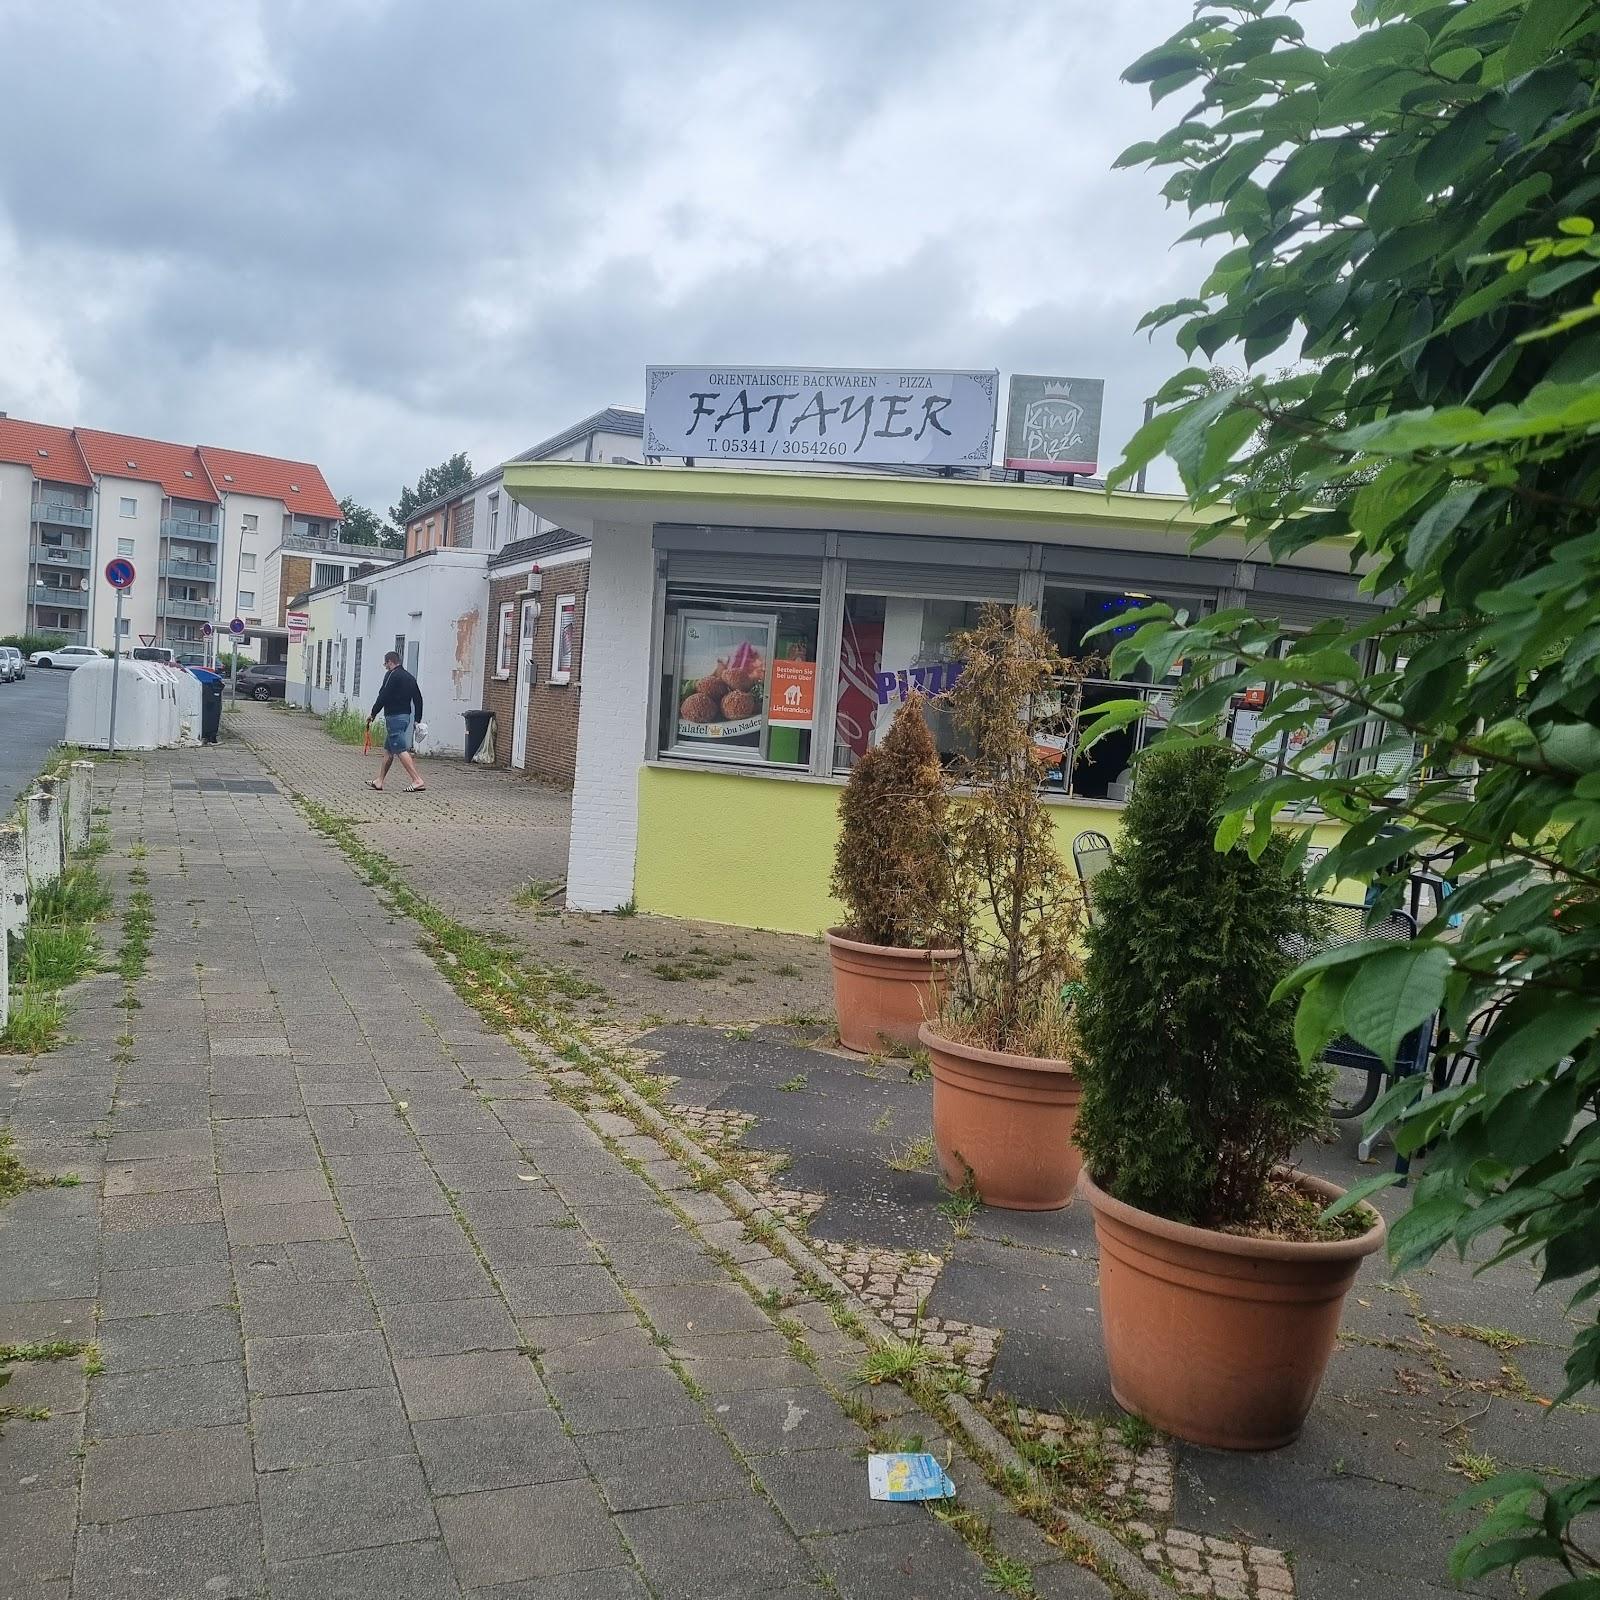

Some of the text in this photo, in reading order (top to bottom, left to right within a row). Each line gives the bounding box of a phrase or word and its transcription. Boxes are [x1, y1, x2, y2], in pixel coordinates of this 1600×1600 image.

[708, 373, 800, 387] ORIENTALISCHE
[803, 375, 878, 389] BACKWAREN
[899, 376, 933, 389] PIZZA
[685, 388, 953, 454] FATAYER
[1022, 402, 1079, 442] King
[707, 438, 718, 452] T.
[721, 438, 766, 453] 05341
[782, 440, 848, 456] 3054260
[1027, 430, 1084, 459] Pizza
[776, 666, 803, 675] Bestellen
[721, 725, 738, 736] Abu
[738, 719, 761, 732] Nader
